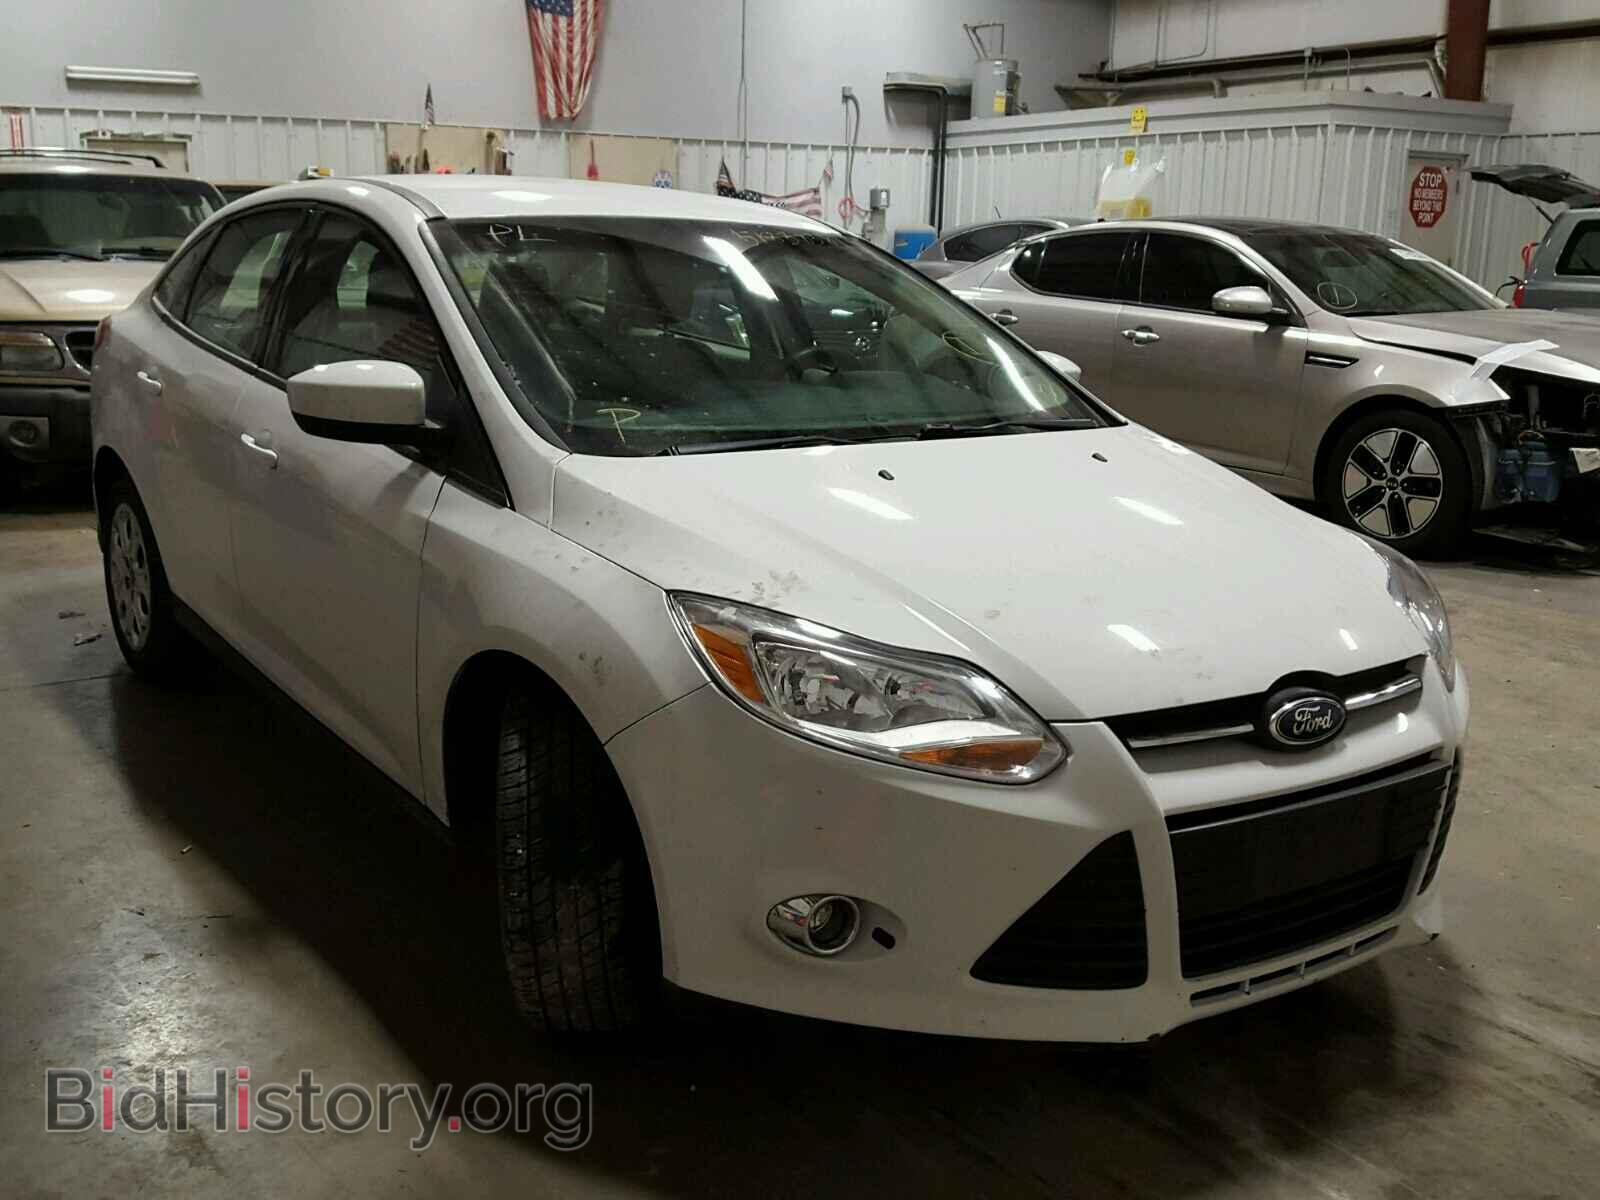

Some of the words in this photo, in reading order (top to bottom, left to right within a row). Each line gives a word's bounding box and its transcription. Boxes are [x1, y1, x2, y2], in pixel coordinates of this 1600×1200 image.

[1419, 172, 1442, 188] STOP
[596, 407, 641, 444] P
[1293, 705, 1333, 735] Ford
